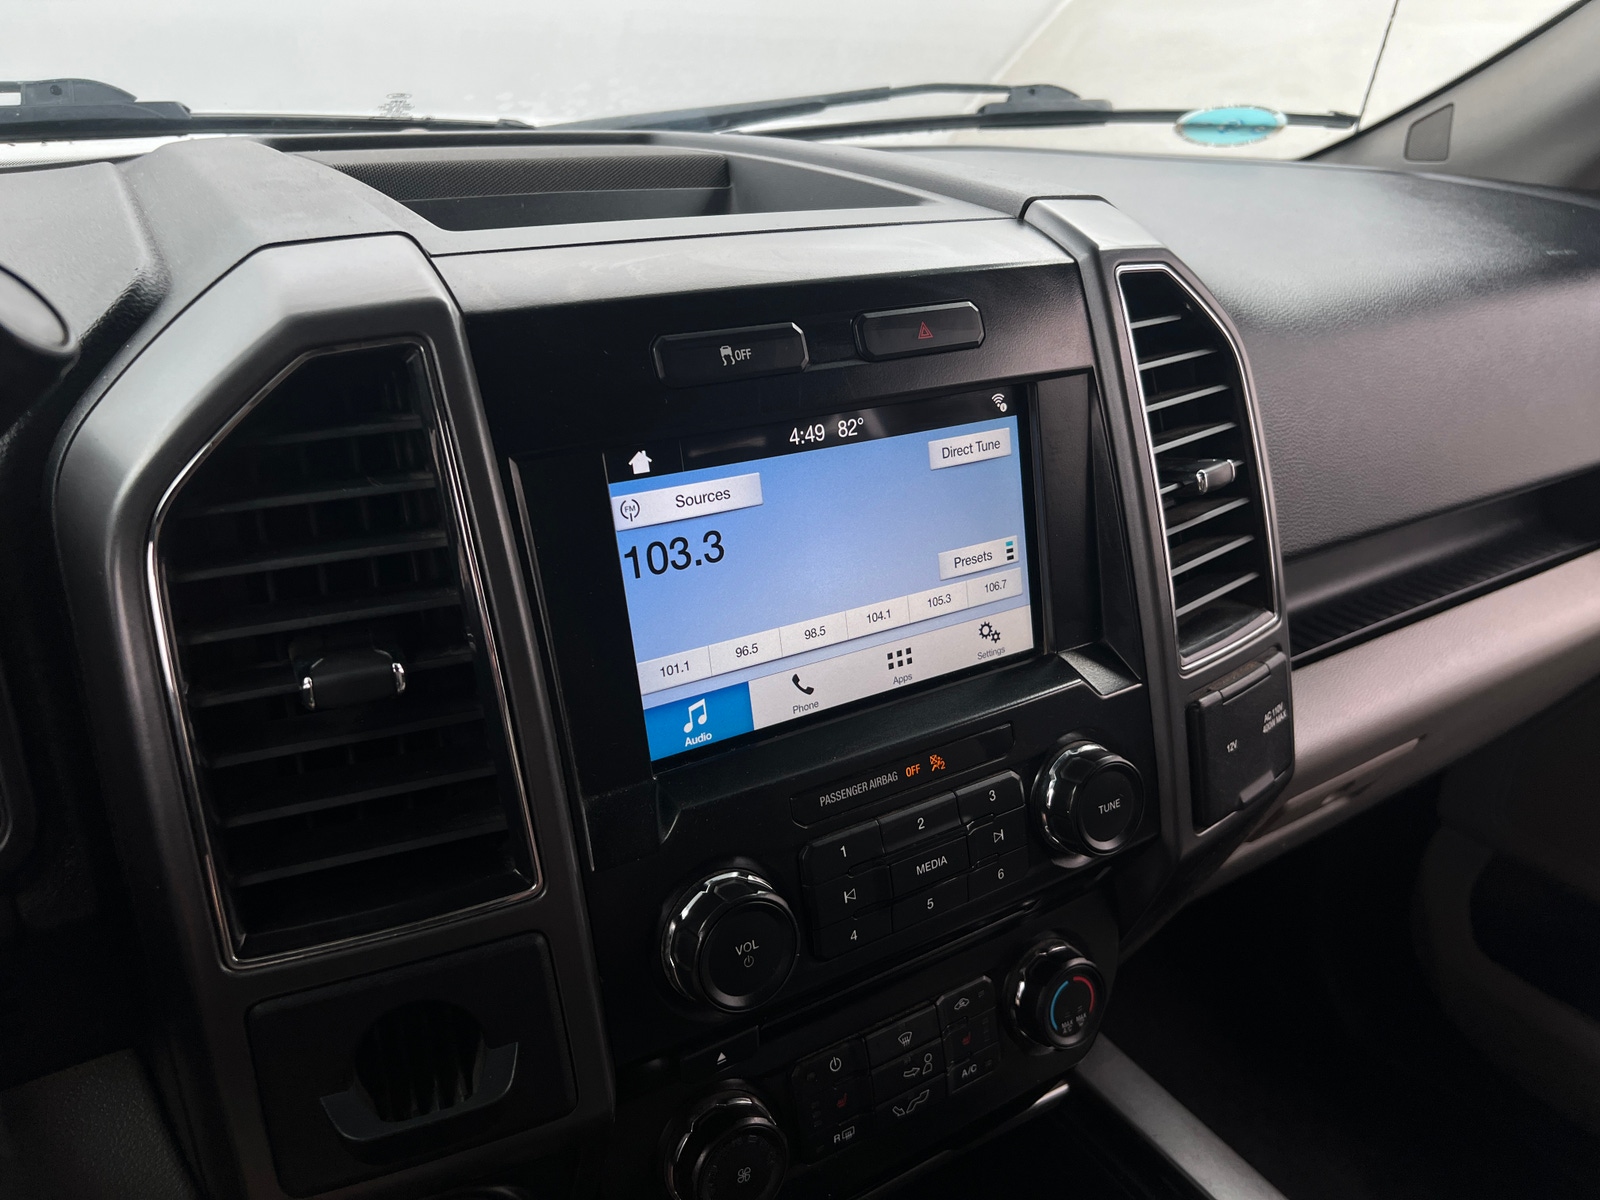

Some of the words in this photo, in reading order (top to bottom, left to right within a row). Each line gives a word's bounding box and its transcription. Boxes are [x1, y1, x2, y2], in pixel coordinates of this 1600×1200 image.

[734, 347, 752, 361] OFF
[788, 423, 826, 446] 4:49
[837, 416, 865, 438] 82°
[941, 442, 973, 460] Direct
[975, 438, 1001, 455] Tune
[675, 489, 731, 508] Sources
[624, 504, 637, 513] FM
[624, 530, 725, 579] 103.3
[953, 549, 993, 569] Presets
[659, 660, 691, 678] 101.1
[735, 642, 759, 658] 96.5
[804, 626, 826, 641] 98.5
[866, 609, 892, 625] 104.1
[927, 593, 952, 609] 105.3
[983, 579, 1008, 594] 106.7
[977, 645, 1006, 662] Settings
[892, 671, 913, 687] Apps
[792, 700, 819, 715] Phone
[684, 732, 713, 747] Audio
[1226, 739, 1238, 753] 12V
[819, 781, 868, 807] PASSENGER
[868, 770, 899, 789] AIRBAG
[905, 763, 921, 778] OFF
[988, 790, 997, 802] 3
[1098, 798, 1122, 816] TUNE
[916, 817, 925, 830] 2
[839, 845, 847, 858] 1
[915, 855, 949, 877] MEDIA
[996, 868, 1005, 880] 6
[926, 897, 935, 910] 5
[849, 929, 859, 942] 4
[734, 939, 760, 957] VOL
[961, 1063, 978, 1079] A/C
[833, 1133, 841, 1143] R
